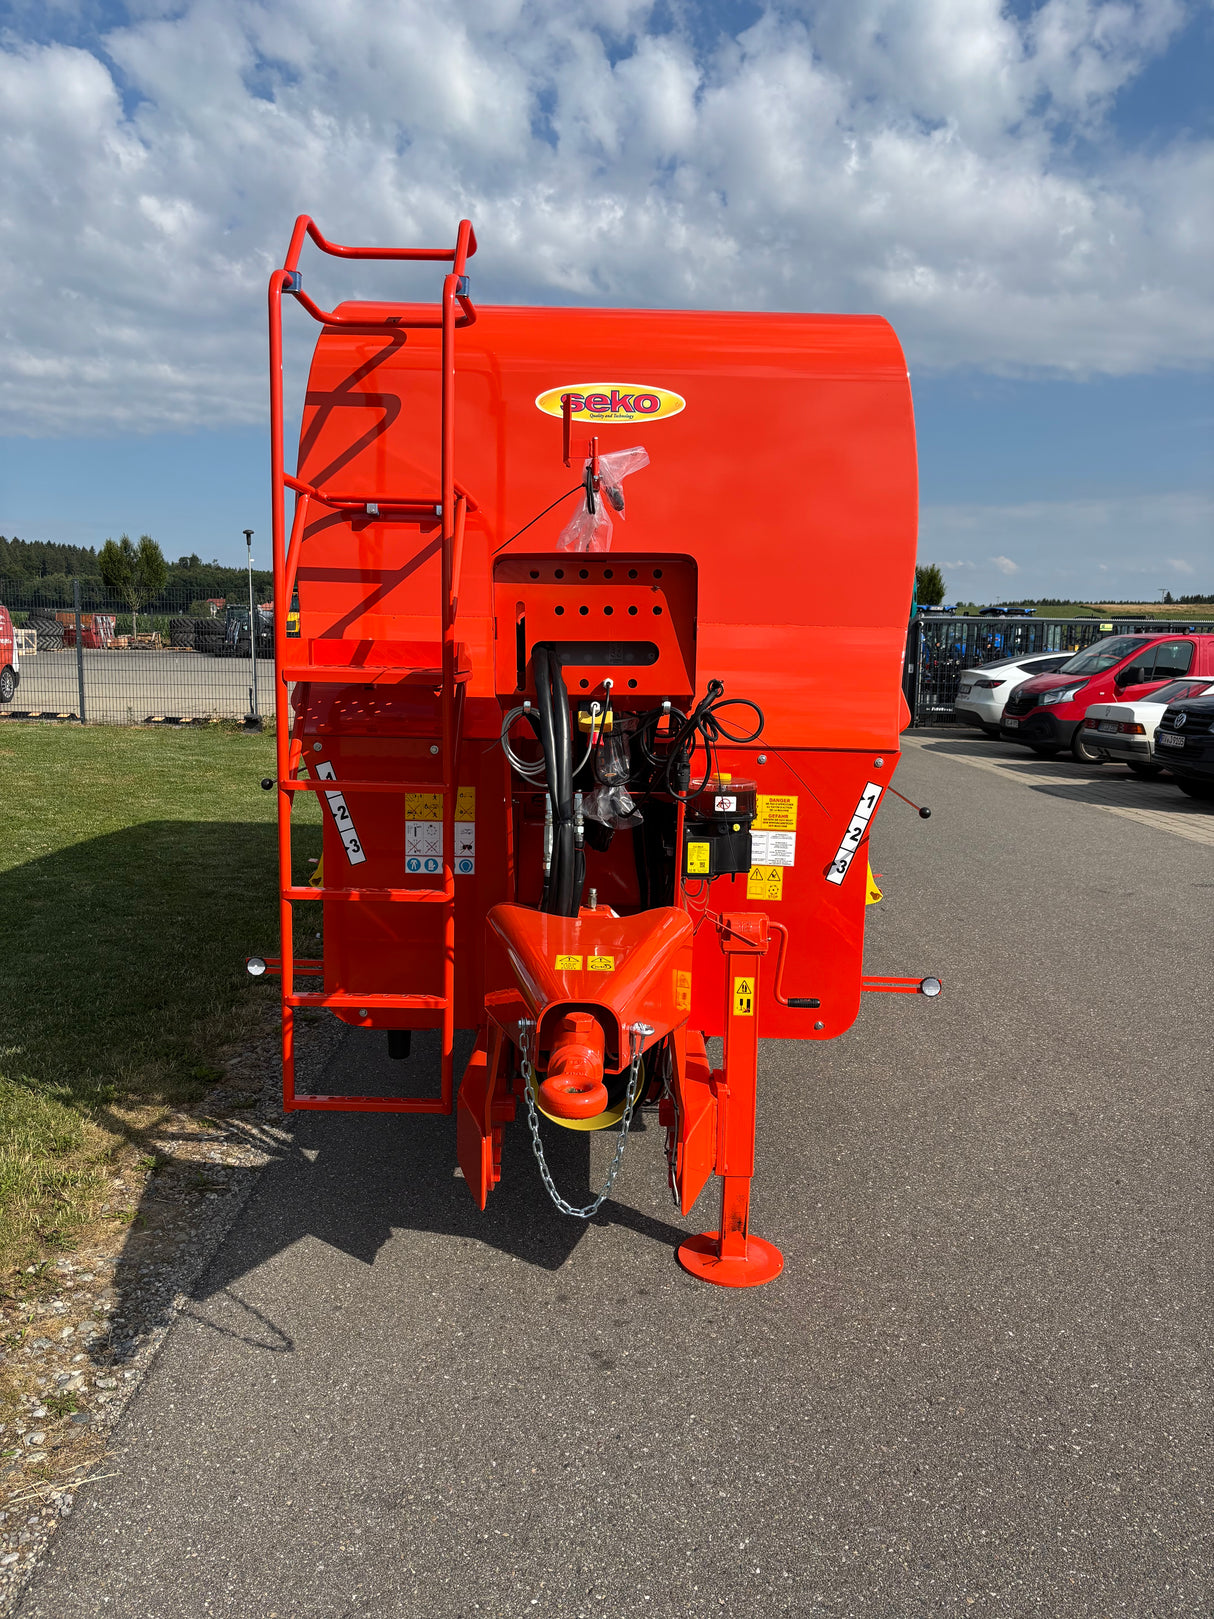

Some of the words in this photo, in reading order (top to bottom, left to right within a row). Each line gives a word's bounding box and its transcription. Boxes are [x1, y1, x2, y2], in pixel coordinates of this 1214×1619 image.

[560, 390, 661, 414] seko
[867, 795, 875, 808] 1
[337, 805, 349, 820] 2
[849, 827, 862, 842] 2
[349, 839, 360, 853] 3
[836, 860, 847, 873] 3
